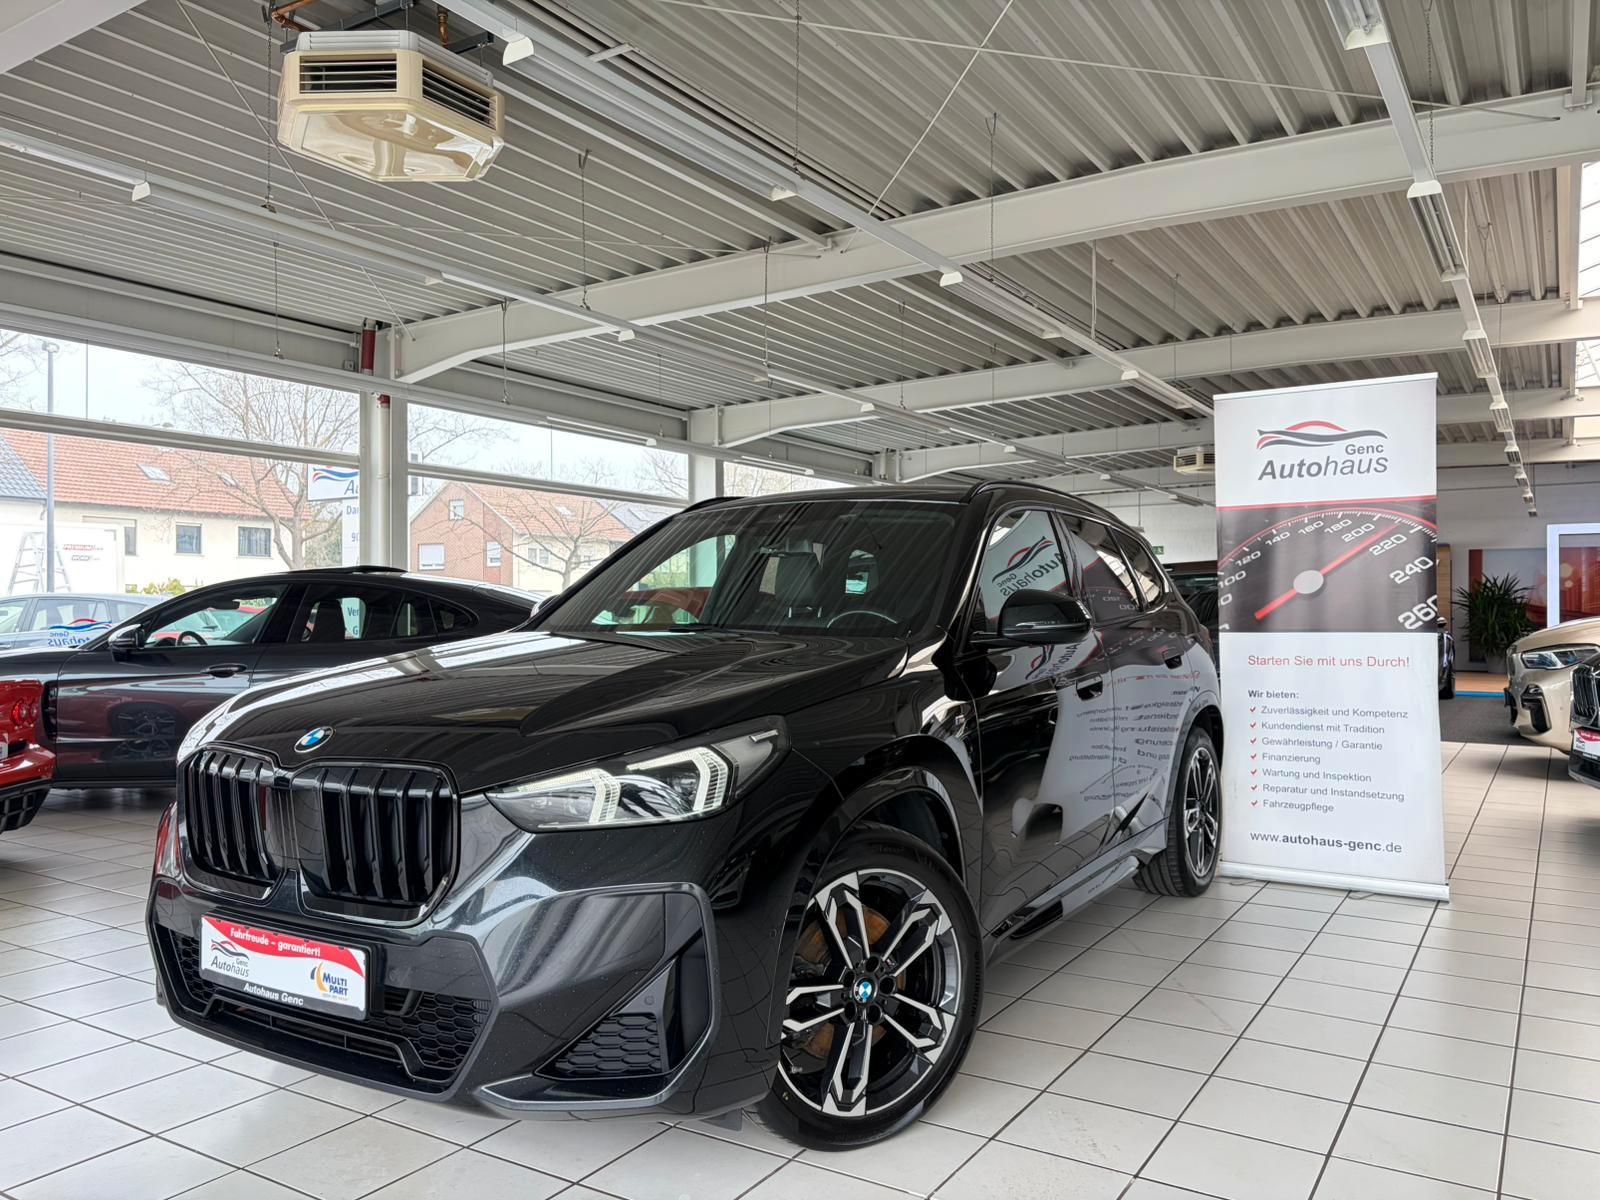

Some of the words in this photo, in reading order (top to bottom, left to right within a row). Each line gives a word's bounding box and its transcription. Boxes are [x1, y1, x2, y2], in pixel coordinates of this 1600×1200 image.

[1345, 444, 1384, 456] Genc
[1258, 455, 1389, 481] Autohaus
[1298, 520, 1324, 534] 160
[1324, 519, 1352, 533] 180
[1341, 523, 1375, 542] 200
[1265, 531, 1290, 546] 140
[1369, 534, 1407, 556] 220
[1235, 550, 1261, 566] 120
[1389, 556, 1434, 584] 240
[1218, 570, 1246, 588] 100
[1218, 593, 1232, 606] 0
[1248, 655, 1289, 665] Starten
[1295, 655, 1313, 666] Sie
[1317, 656, 1336, 666] mit
[1340, 658, 1362, 667] uns
[1367, 656, 1410, 667] Durch!
[1248, 690, 1264, 698] Wir
[1266, 690, 1299, 699] bieten:
[1261, 706, 1329, 716] Zuverlässigkeit
[1332, 708, 1349, 716] und
[1352, 708, 1408, 719] Kompetenz
[1261, 722, 1323, 731] Kundendienst
[1326, 724, 1341, 732] mit
[1344, 724, 1385, 734] Tradition
[1261, 737, 1333, 749] Gewährleistung
[1341, 740, 1383, 750] Garantie
[1262, 753, 1321, 765] Finanzierung
[1262, 768, 1300, 779] Wartung
[1302, 771, 1320, 779] und
[1323, 771, 1372, 782] Inspektion
[1262, 784, 1308, 794] Reparatur
[1310, 786, 1328, 795] und
[1330, 788, 1405, 802] Instandsetzung
[1263, 799, 1334, 813] Fahrzeugpflege
[1250, 832, 1402, 853] www.autohaus-genc.de
[230, 927, 269, 945] Fahrfreude
[277, 940, 321, 957] garantiert!
[210, 955, 250, 977] Autohaus
[323, 972, 347, 987] MULTI
[243, 982, 280, 1000] Autohaus
[281, 992, 304, 1006] Genc
[329, 984, 348, 996] PART
